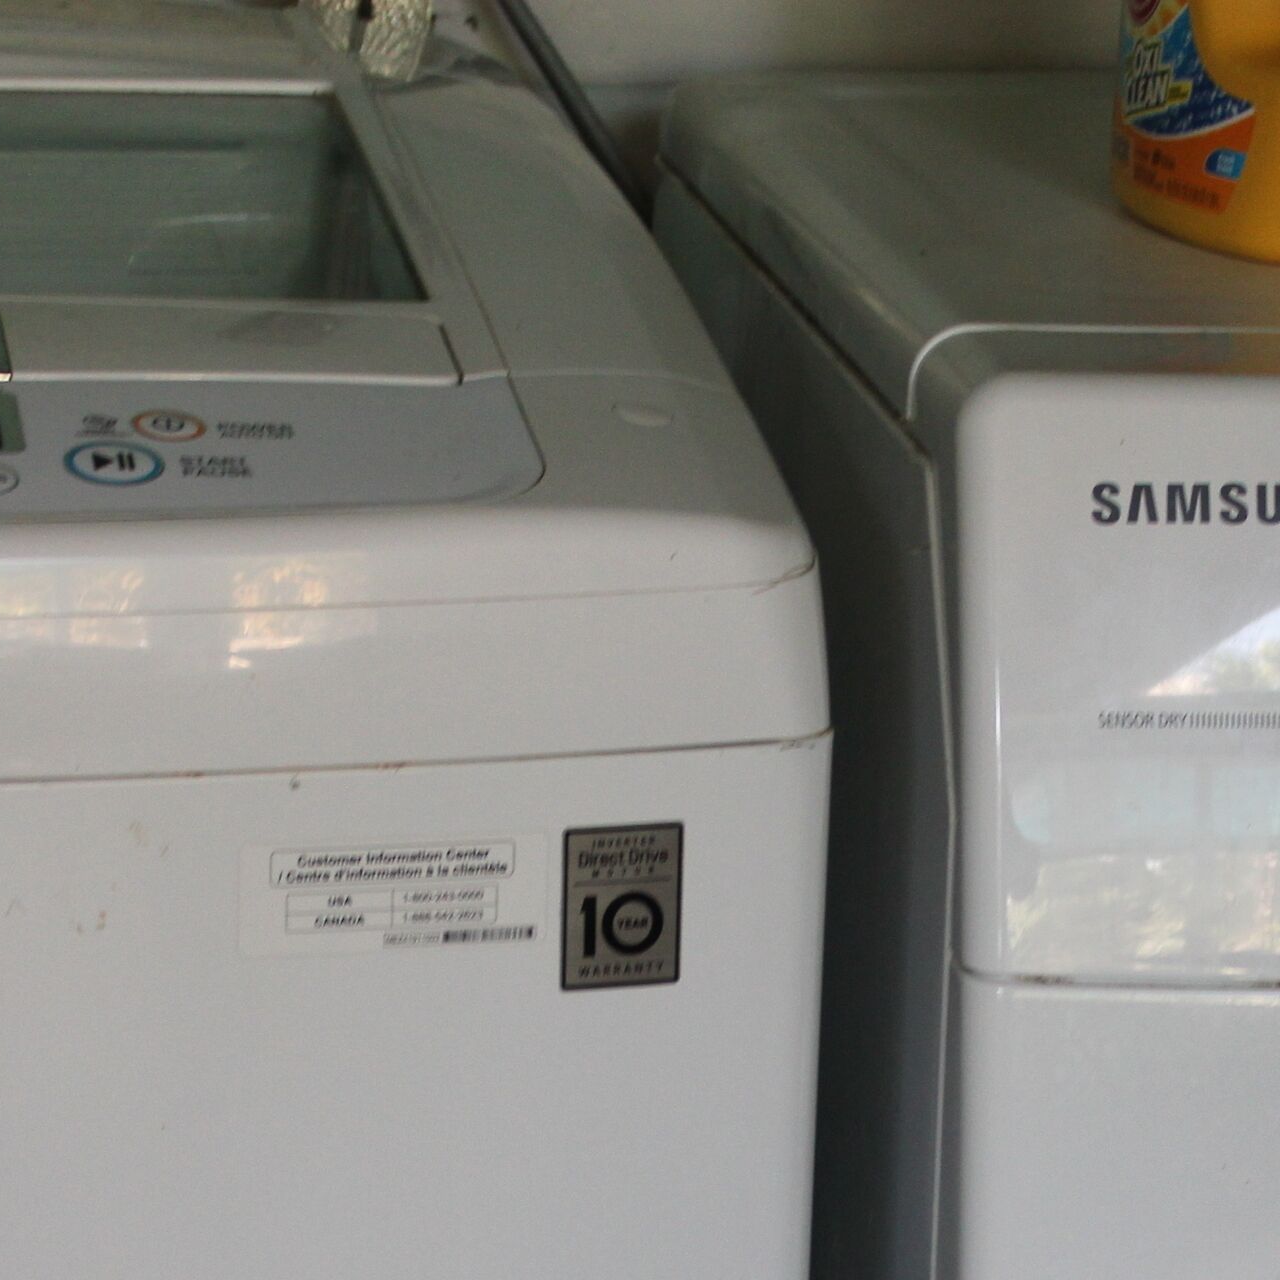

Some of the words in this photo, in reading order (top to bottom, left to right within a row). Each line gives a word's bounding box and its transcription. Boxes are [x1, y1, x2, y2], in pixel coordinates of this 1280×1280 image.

[1097, 710, 1155, 729] SENSOR
[1158, 710, 1188, 729] DRY
[296, 853, 363, 869] Customer
[366, 849, 443, 866] Information
[446, 846, 490, 862] Center
[578, 850, 624, 869] Direct
[628, 848, 669, 867] Drive
[286, 868, 331, 885] Centre
[334, 863, 422, 882] d'information
[437, 861, 449, 876] la
[327, 894, 353, 907] USA
[313, 913, 365, 928] CANADA
[580, 889, 664, 960] 10
[617, 916, 649, 931] YEAR
[579, 960, 664, 978] WARRANTY
